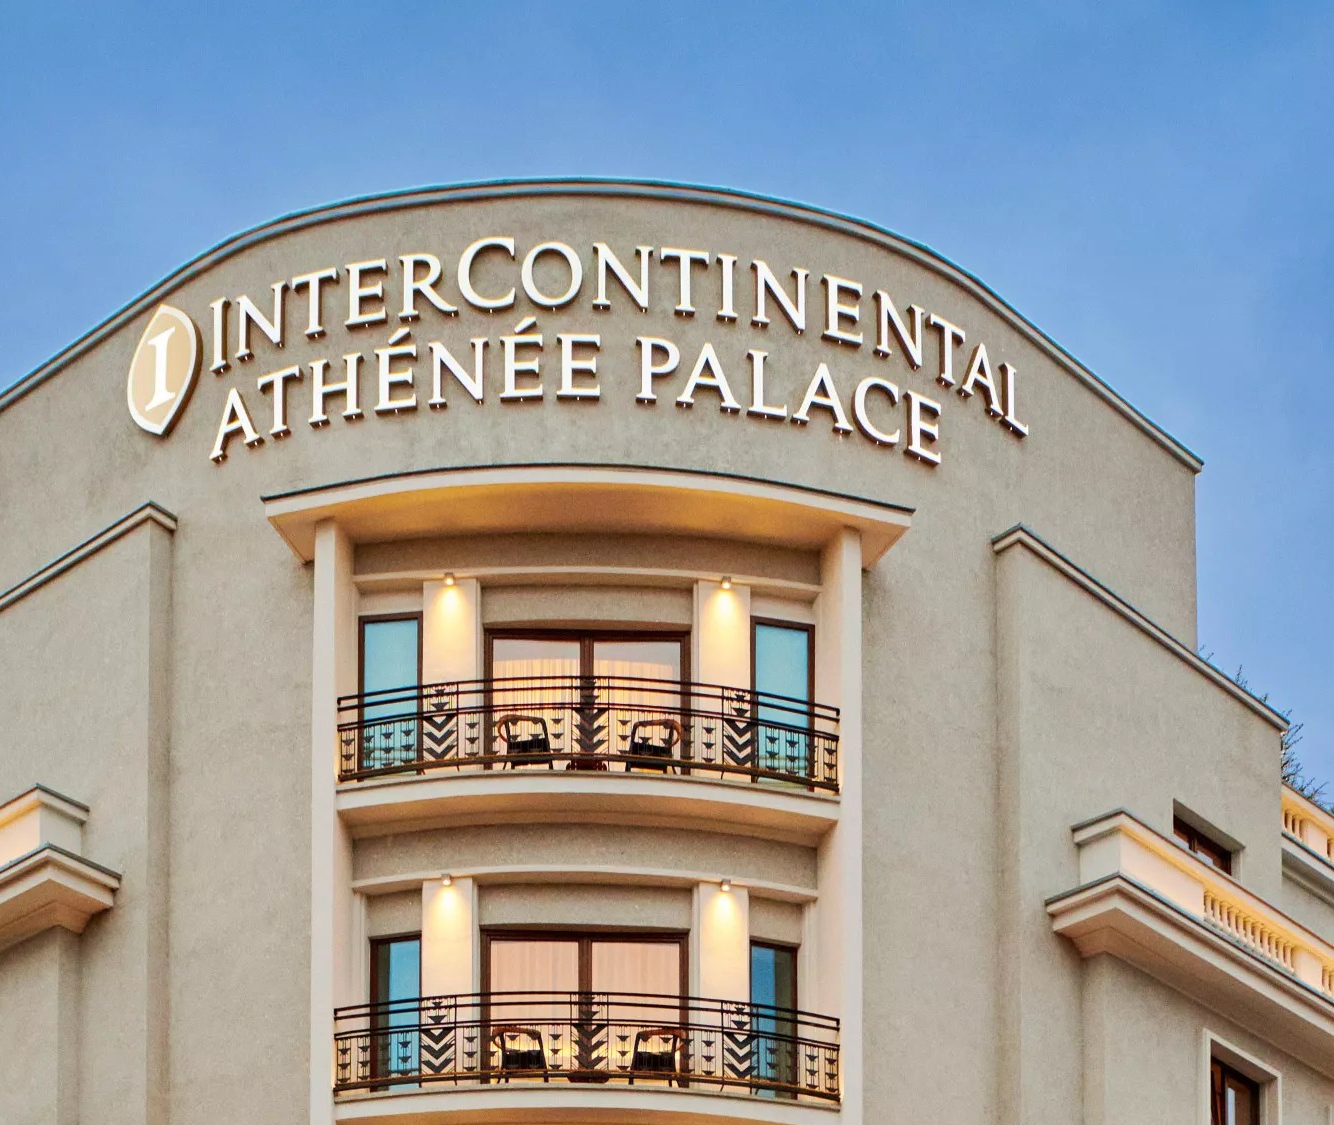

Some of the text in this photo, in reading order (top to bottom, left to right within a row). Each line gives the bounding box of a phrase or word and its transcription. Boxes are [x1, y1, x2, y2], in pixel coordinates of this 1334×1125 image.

[209, 236, 1029, 437] INTERCONTINENTAL
[209, 316, 942, 465] ATHÉNÉE PALACE
